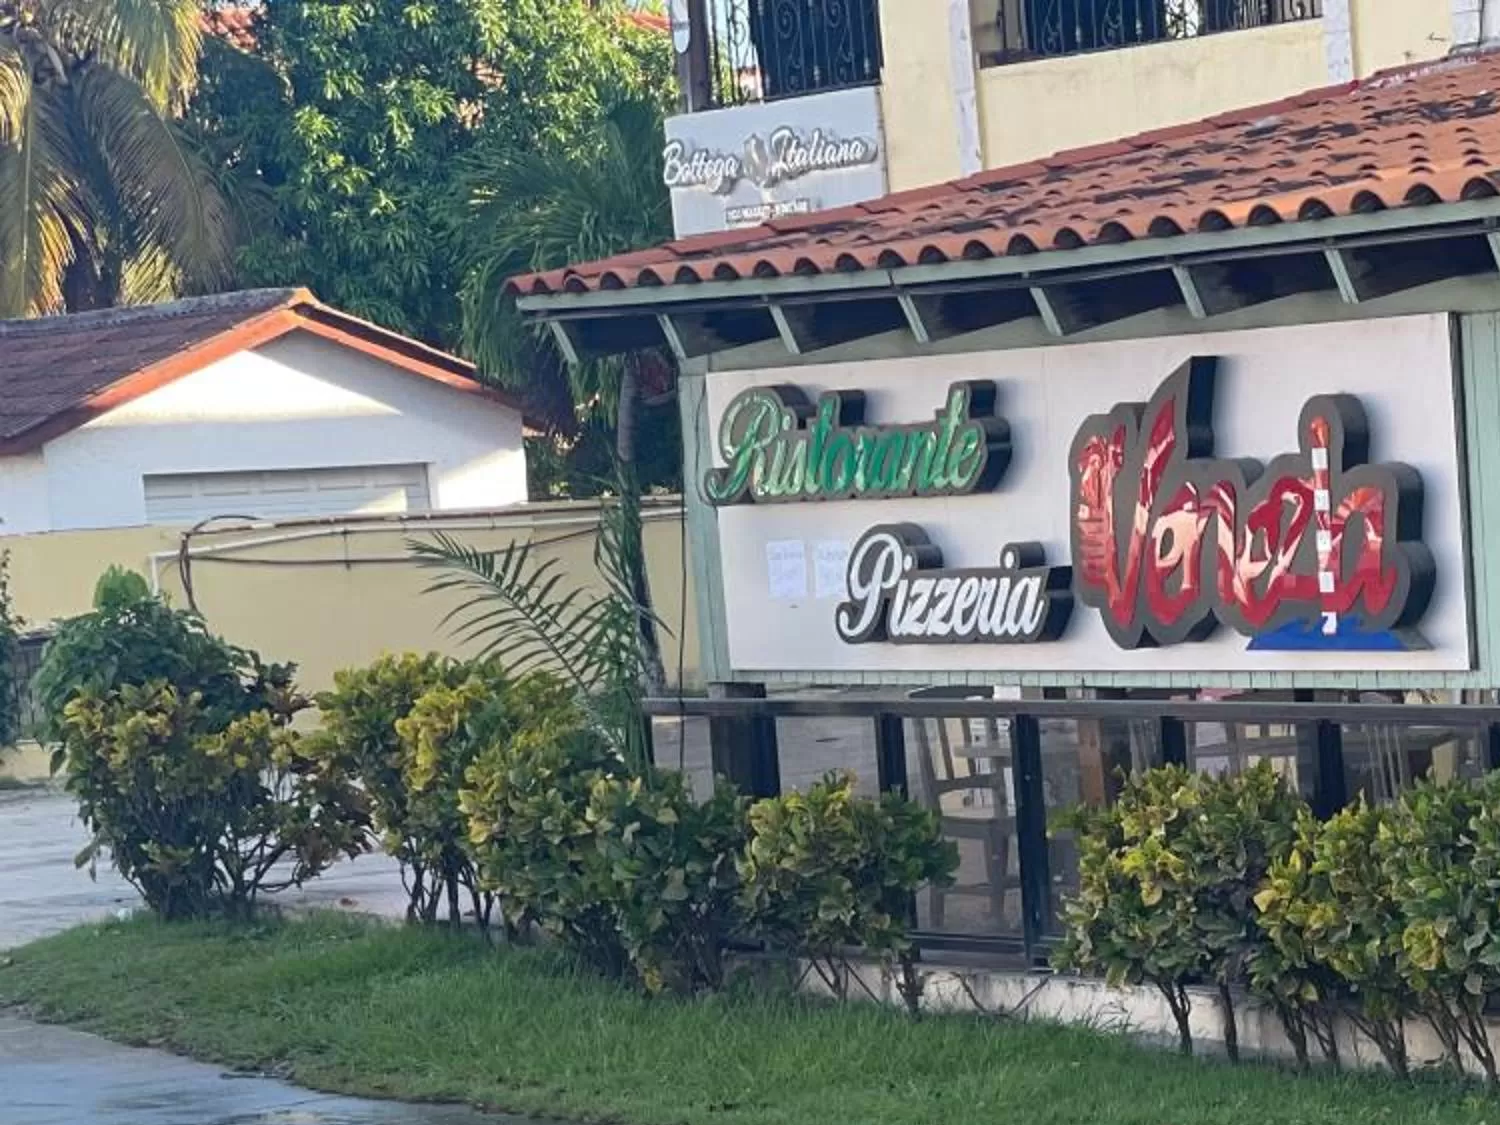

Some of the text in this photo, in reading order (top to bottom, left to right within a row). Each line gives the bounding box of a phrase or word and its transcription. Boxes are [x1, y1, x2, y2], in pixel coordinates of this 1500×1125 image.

[664, 129, 864, 193] Bottega Italiana
[705, 387, 982, 497] Ristorante
[839, 533, 1046, 637] Pizzeria
